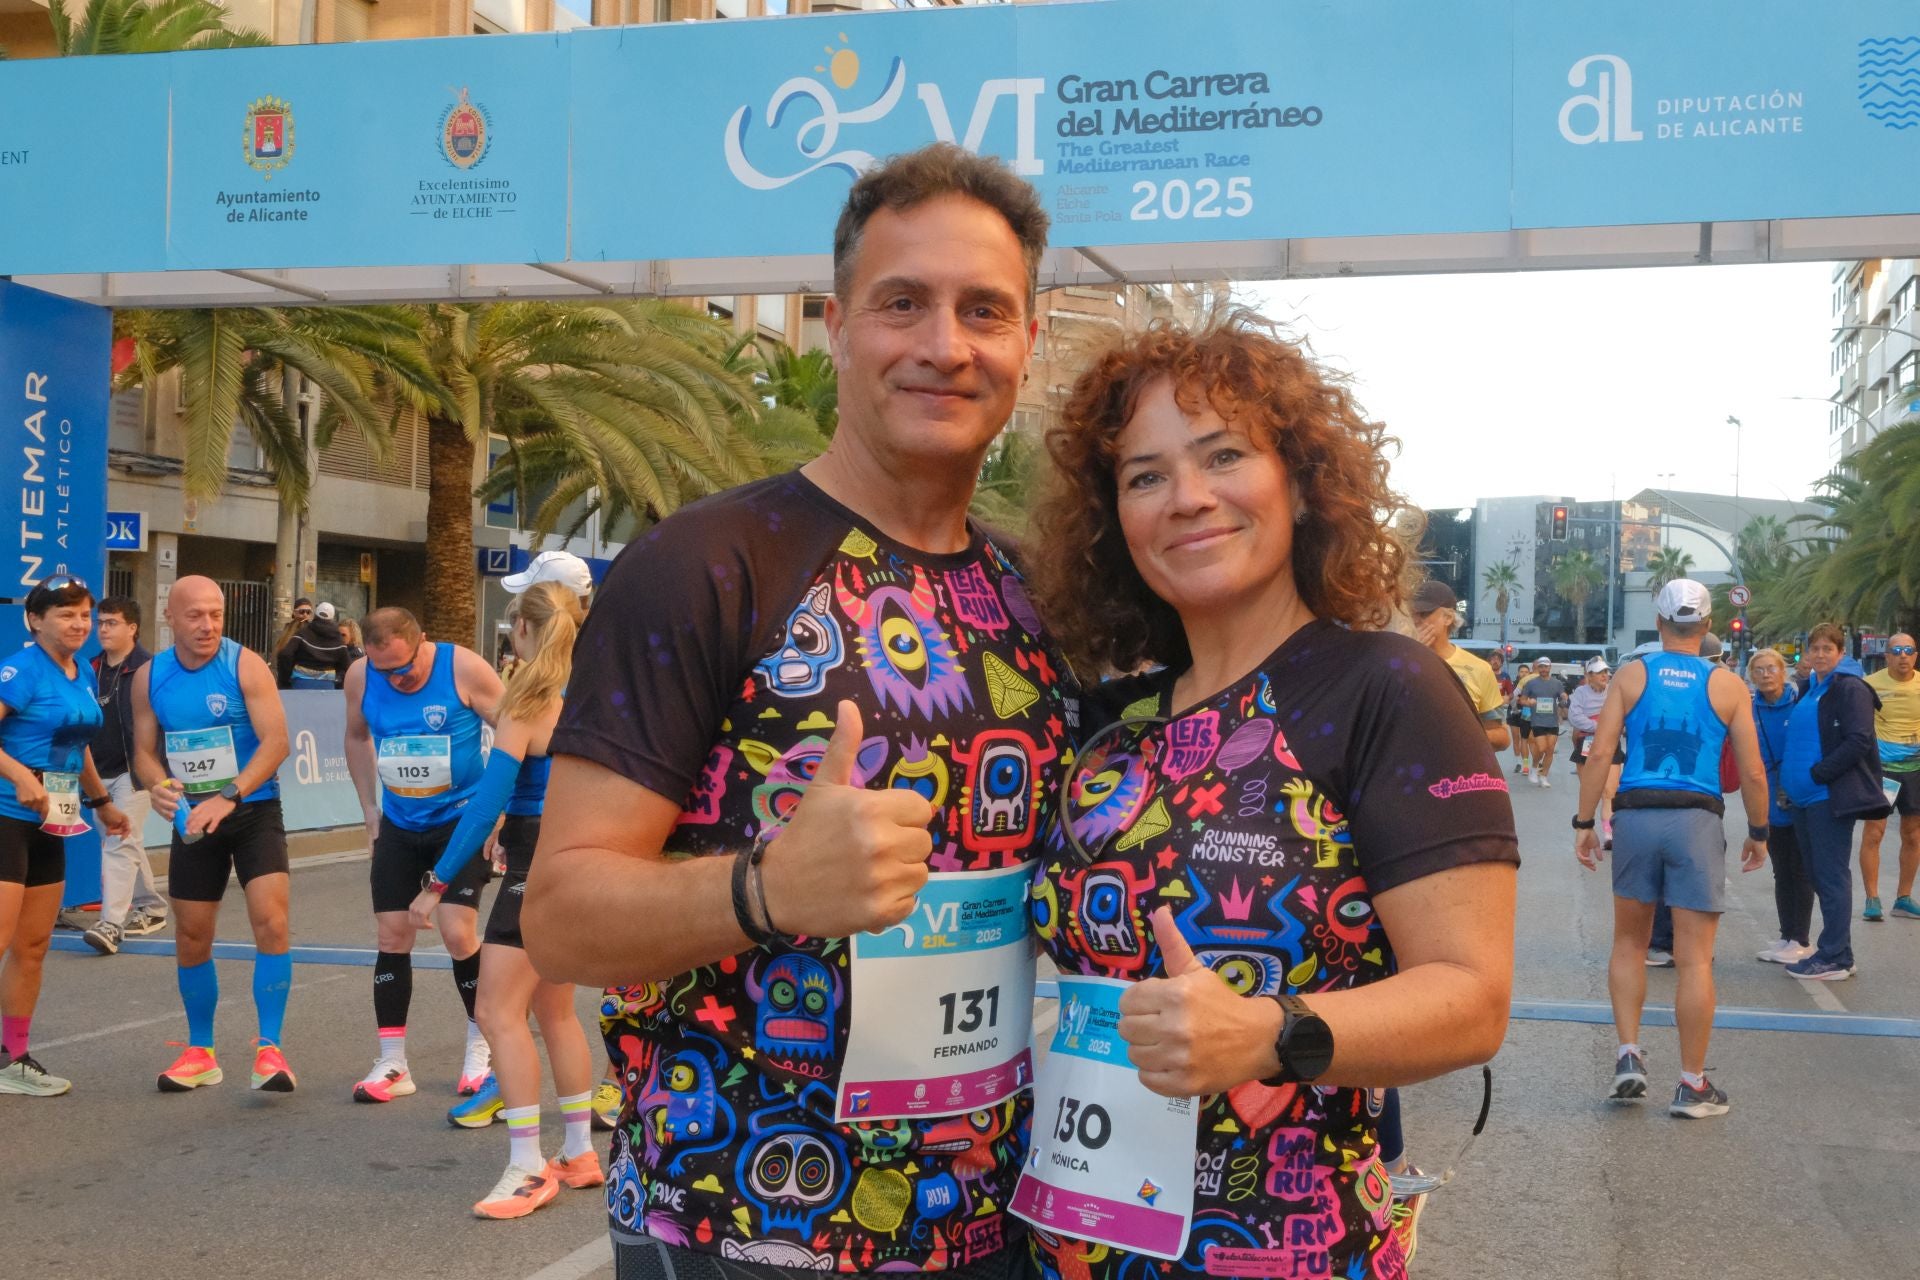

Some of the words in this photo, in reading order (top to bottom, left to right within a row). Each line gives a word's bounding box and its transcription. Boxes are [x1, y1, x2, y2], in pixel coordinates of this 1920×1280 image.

[1057, 74, 1138, 104] Gran
[1144, 70, 1270, 99] Carrera
[1657, 89, 1804, 115] DIPUTACIÓN
[917, 76, 1046, 176] VI
[1057, 109, 1104, 137] del
[1112, 102, 1323, 135] Mediterráneo
[1657, 123, 1684, 139] DE
[1694, 117, 1804, 137] ALICANTE
[1057, 141, 1094, 157] The
[1099, 138, 1180, 155] Greatest
[1057, 155, 1198, 174] Mediterranean
[1204, 153, 1250, 168] Race
[216, 188, 321, 208] Ayuntamiento
[411, 191, 517, 205] AYUNTAMIENTO
[1130, 176, 1254, 221] 2025
[226, 208, 245, 223] de
[248, 207, 308, 222] Alicante
[433, 207, 448, 219] de
[452, 207, 493, 219] ELCHE
[56, 418, 71, 549] ATLÉTICO
[20, 371, 48, 650] NTEMAR
[957, 594, 1004, 624] RUN
[182, 758, 216, 773] 1247
[323, 757, 347, 768] DIPUT
[397, 766, 430, 778] 1103
[1168, 748, 1213, 774] RUN
[1203, 829, 1278, 850] RUNNING
[1191, 843, 1285, 868] MONSTER
[922, 902, 960, 933] VI
[975, 928, 1003, 944] 2025
[939, 985, 1000, 1035] 131
[933, 1037, 998, 1059] FERNANDO
[1088, 1038, 1112, 1055] 2025
[1053, 1096, 1112, 1150] 130
[1051, 1151, 1090, 1174] MÓNICA
[926, 1185, 951, 1208] BUH
